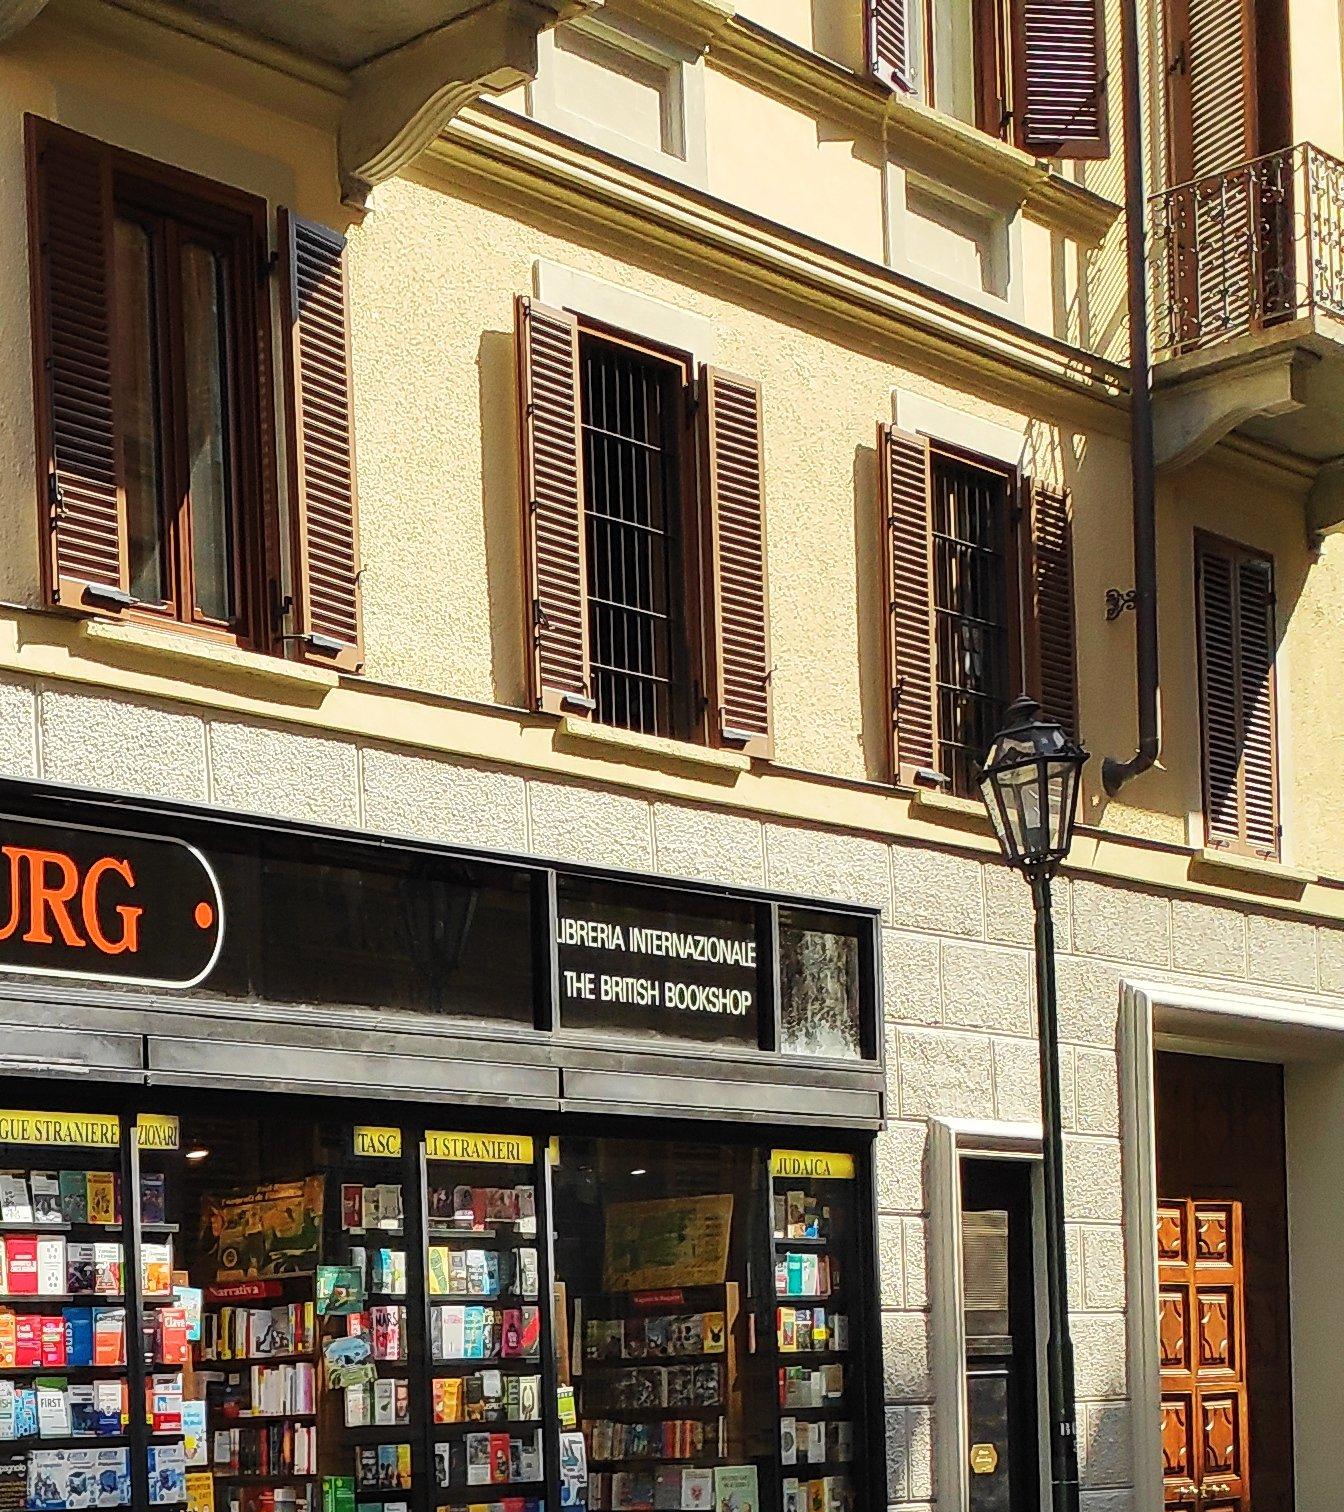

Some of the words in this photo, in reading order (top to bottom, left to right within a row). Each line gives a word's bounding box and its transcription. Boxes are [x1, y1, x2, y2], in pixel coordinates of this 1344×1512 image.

[556, 917, 625, 951] LIBRERIA
[629, 926, 757, 968] INTERNAZIONALE
[564, 970, 595, 1000] THE
[600, 976, 660, 1006] BRITISH
[664, 982, 752, 1016] BOOKSHOP
[35, 1120, 119, 1144] STRANIERE
[442, 1138, 521, 1161] STRANIERI
[776, 1158, 831, 1176] JUDAICA
[40, 1398, 62, 1408] FIRST
